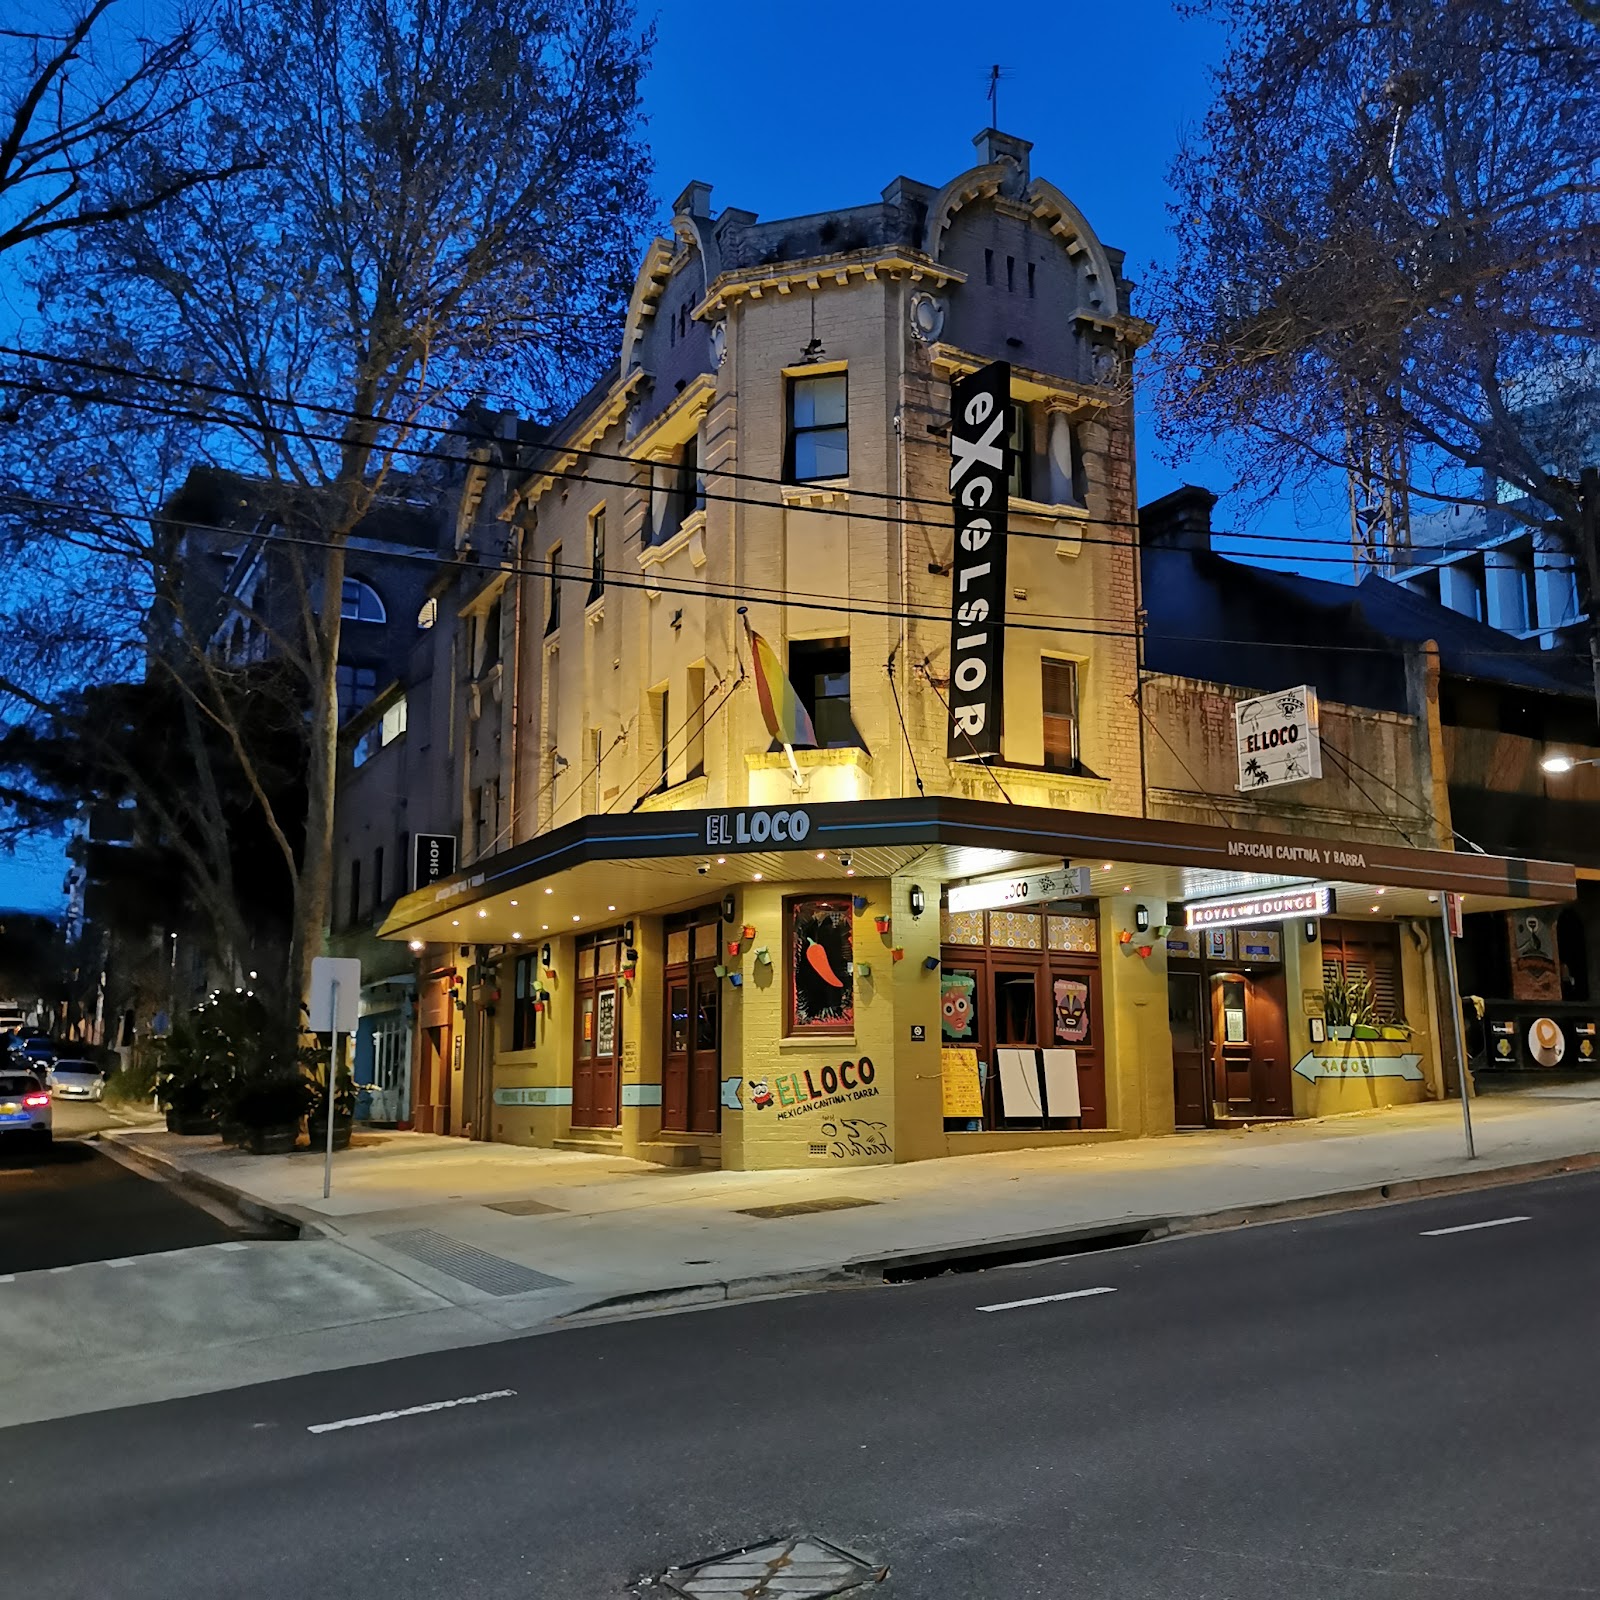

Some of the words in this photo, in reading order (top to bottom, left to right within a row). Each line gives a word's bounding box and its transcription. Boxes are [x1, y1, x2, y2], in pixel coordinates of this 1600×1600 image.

[1261, 724, 1298, 751] LOCO
[706, 814, 733, 845] EL
[736, 809, 810, 844] LOCO
[429, 840, 439, 875] SHOP
[1228, 841, 1273, 859] MEXICAN
[1276, 845, 1320, 863] CANTINA
[1323, 850, 1330, 864] Y
[1333, 851, 1366, 868] BARRA
[1195, 906, 1237, 922] ROYAL
[1254, 897, 1313, 915] LOUNGE
[775, 1073, 808, 1108] EL
[803, 1056, 875, 1101] LOCO
[1321, 1060, 1369, 1074] TACOS
[777, 1103, 813, 1120] MEXICAN
[813, 1094, 846, 1110] CANTINA
[846, 1093, 852, 1102] Y
[853, 1087, 879, 1100] BARRA
